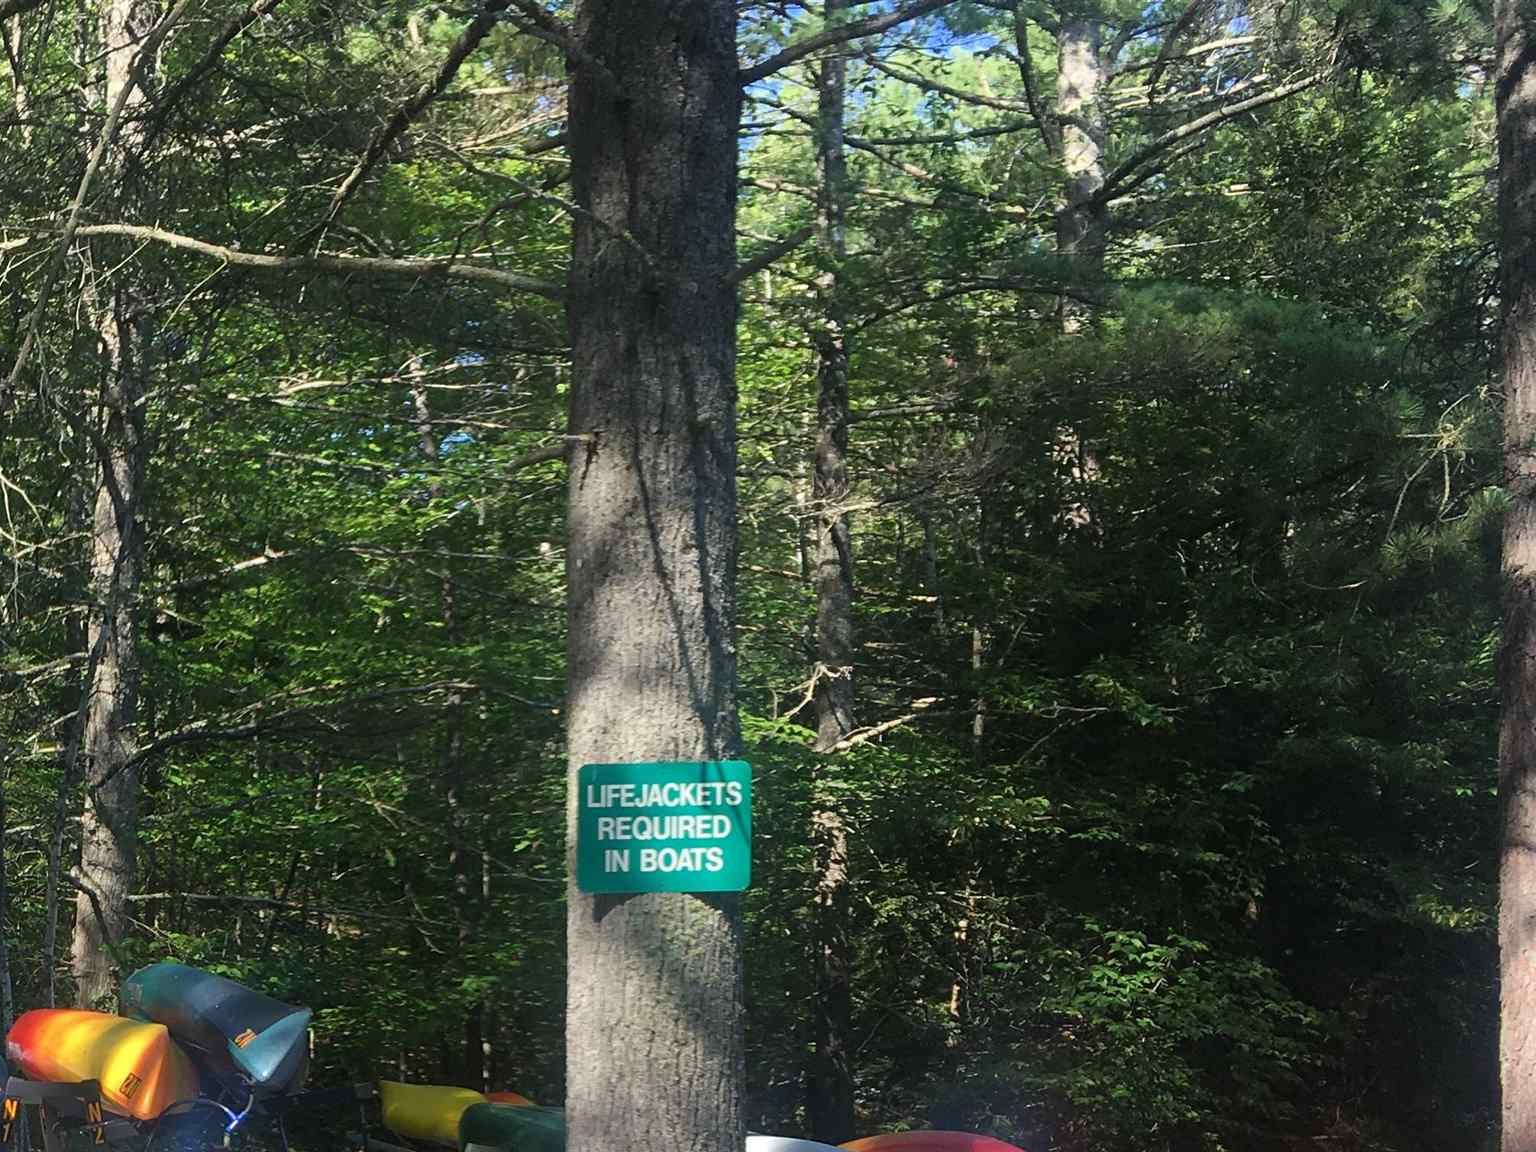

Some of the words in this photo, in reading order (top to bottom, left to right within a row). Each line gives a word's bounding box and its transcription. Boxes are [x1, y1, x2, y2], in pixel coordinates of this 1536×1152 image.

[586, 781, 743, 808] LIFEJACKETS
[597, 815, 732, 841] REQUIRED
[604, 849, 630, 873] IN
[639, 847, 725, 873] BOATS
[3, 1099, 18, 1120] N
[87, 1101, 103, 1122] N
[2, 1121, 11, 1142] 1
